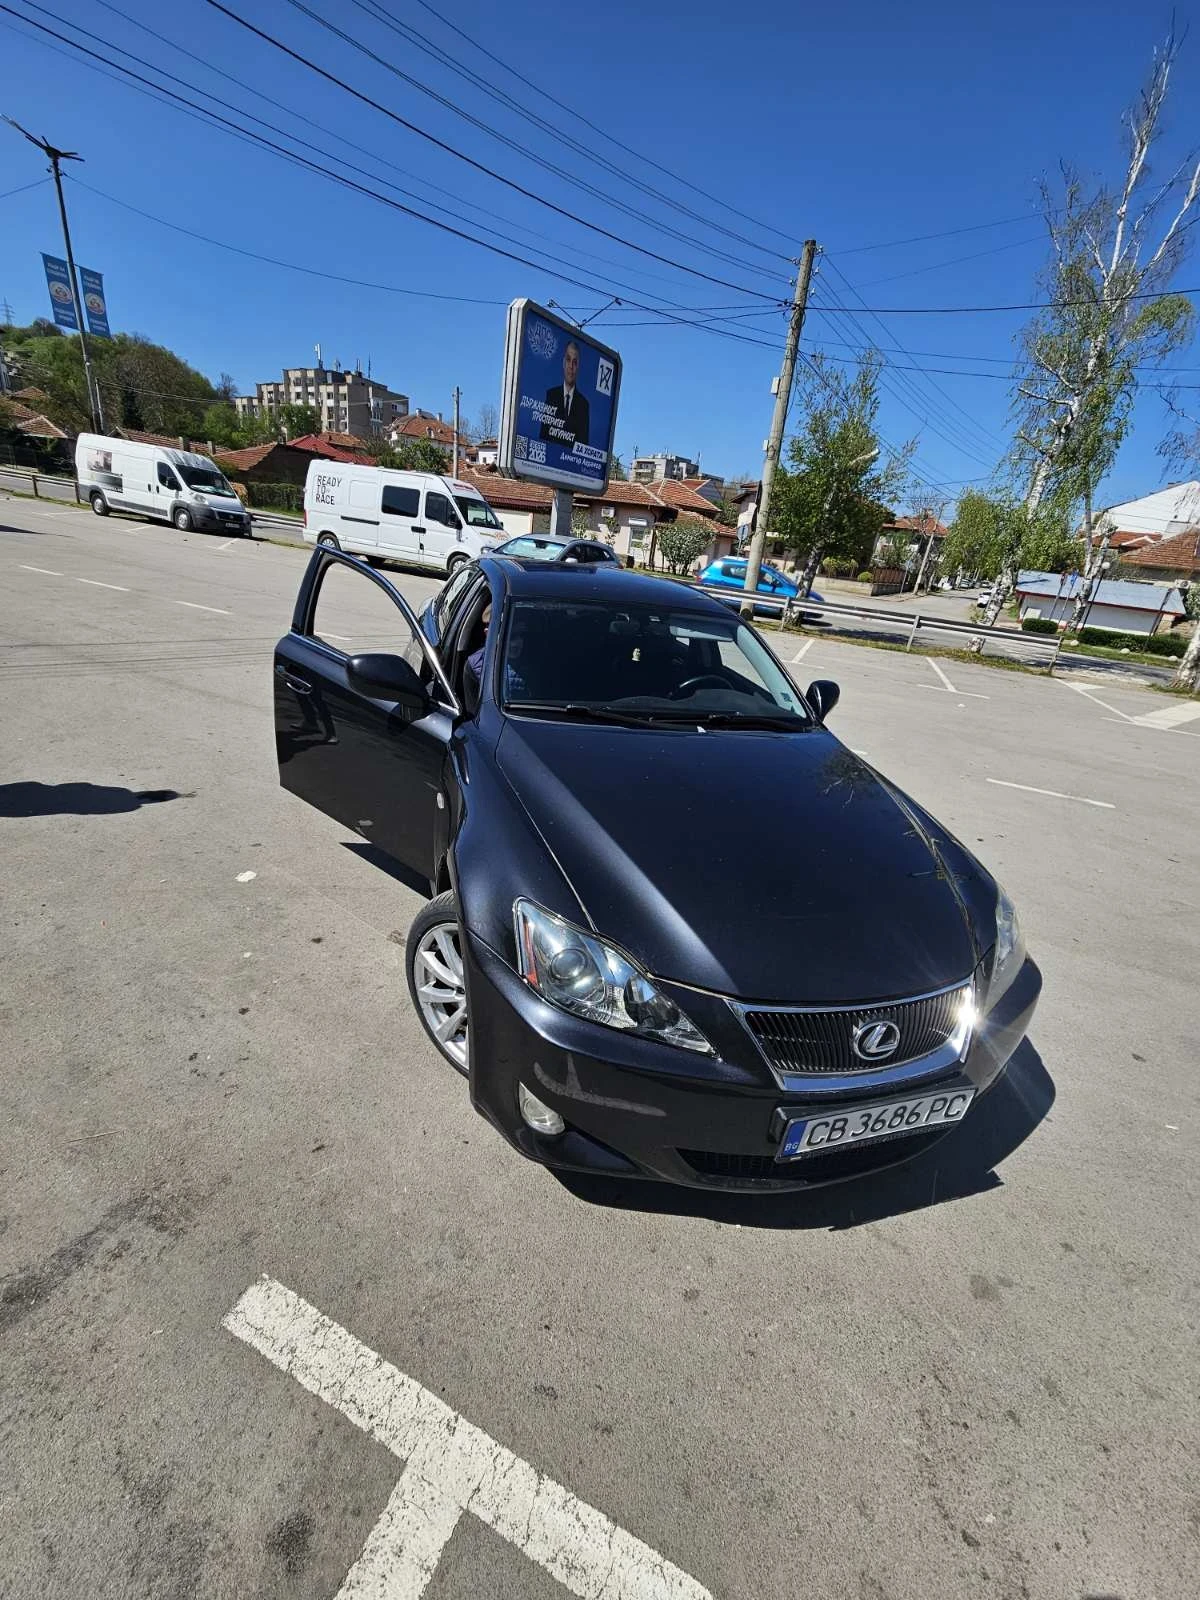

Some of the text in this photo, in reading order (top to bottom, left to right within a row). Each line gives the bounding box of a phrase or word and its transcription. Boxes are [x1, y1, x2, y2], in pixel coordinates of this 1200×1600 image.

[520, 396, 557, 416] ДЪРЖАВНОСТ
[317, 475, 342, 487] READY
[317, 484, 326, 495] TO
[315, 494, 335, 505] RACE
[850, 1102, 923, 1137] 3686
[785, 1142, 799, 1152] BG
